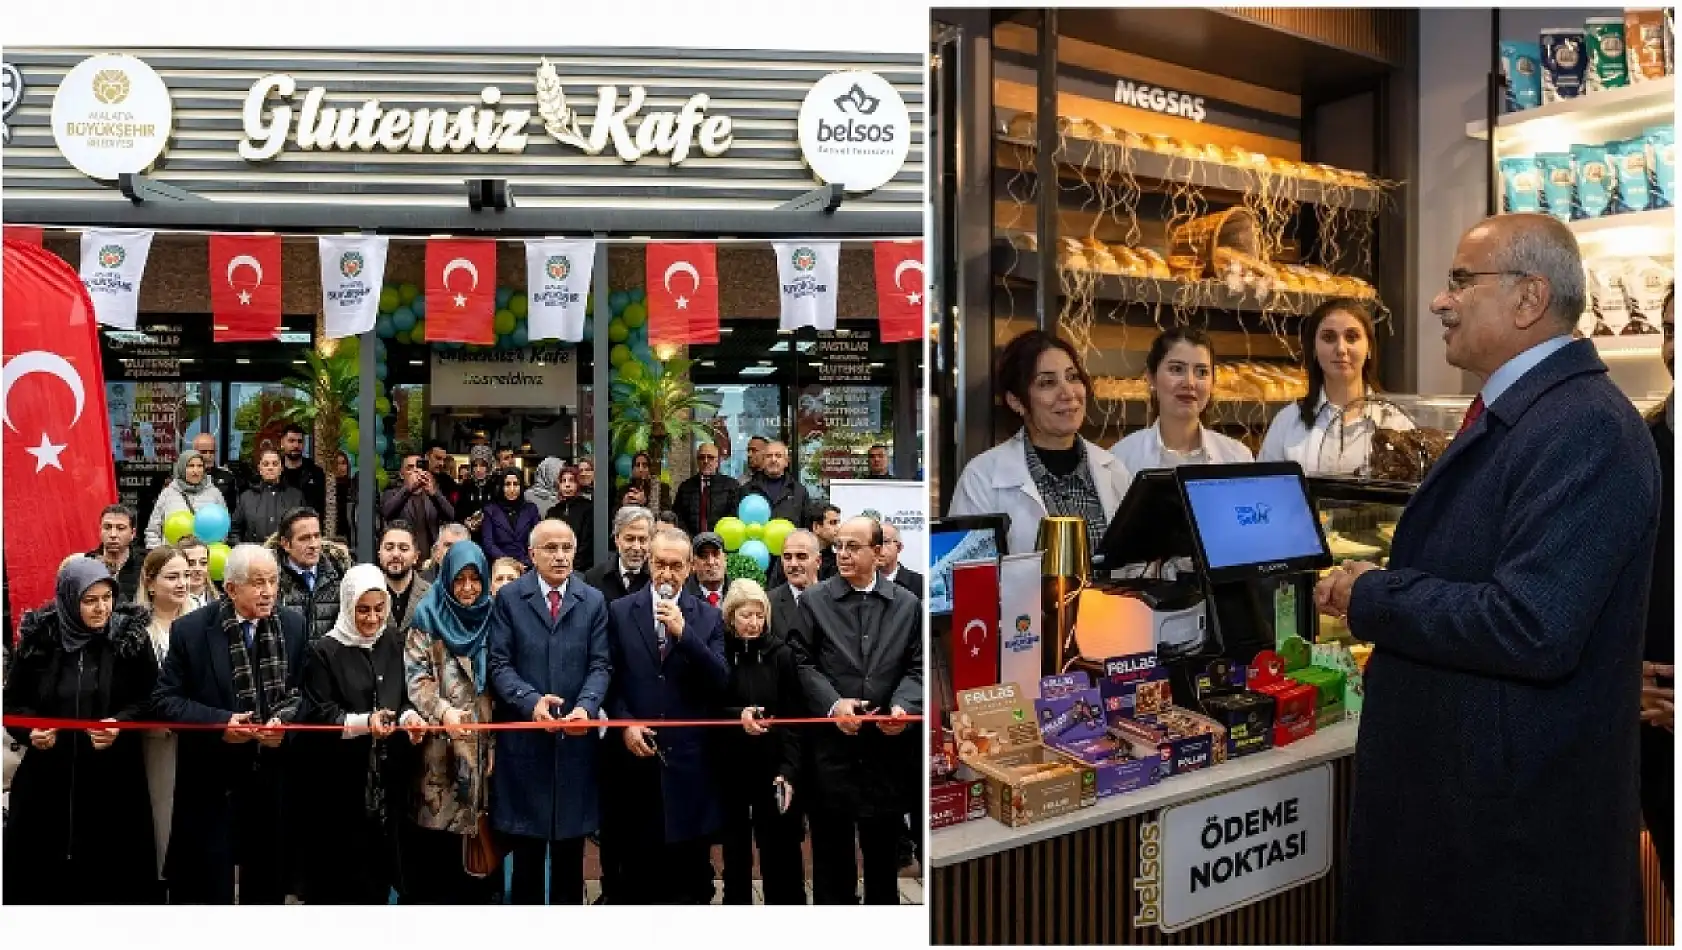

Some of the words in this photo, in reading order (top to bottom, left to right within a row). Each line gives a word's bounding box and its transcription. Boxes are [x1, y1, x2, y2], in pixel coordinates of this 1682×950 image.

[238, 73, 531, 162] Glutensiz
[587, 85, 733, 166] Kafe
[817, 118, 895, 142] belsos
[1201, 797, 1299, 850] ÖDEME
[1134, 823, 1160, 928] belsos
[1190, 830, 1307, 893] NOKTASI
